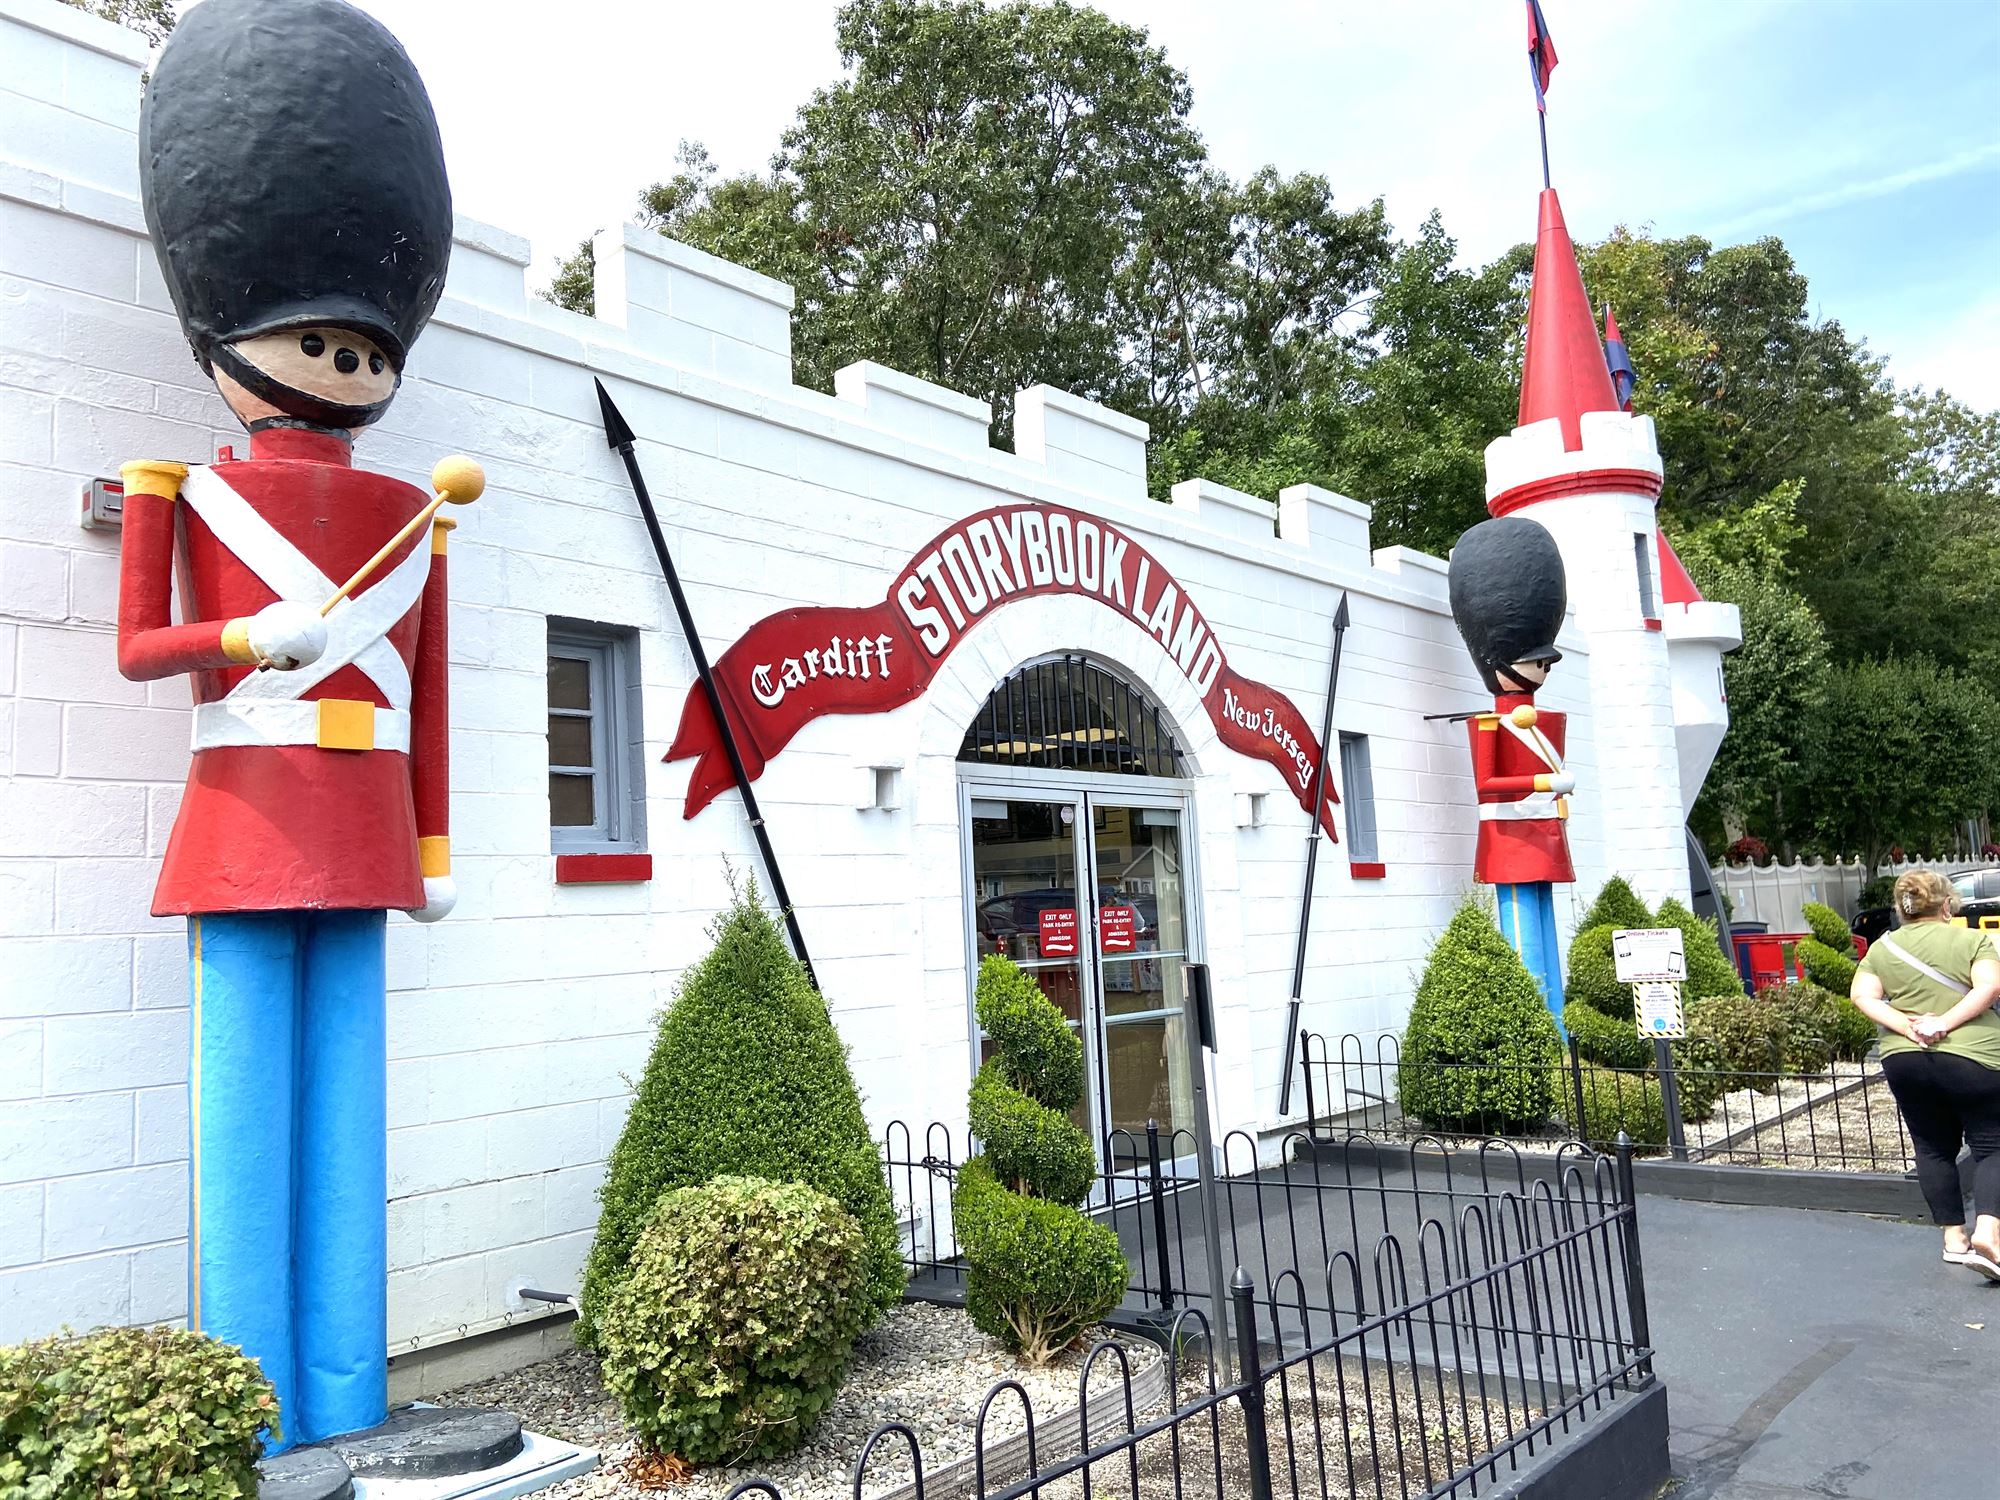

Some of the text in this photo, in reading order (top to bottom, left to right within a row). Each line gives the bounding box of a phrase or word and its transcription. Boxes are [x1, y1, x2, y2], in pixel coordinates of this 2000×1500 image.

[897, 511, 1223, 699] STORYBOOK LAND
[751, 633, 893, 707] Cardiff
[1222, 688, 1314, 790] New Jersey
